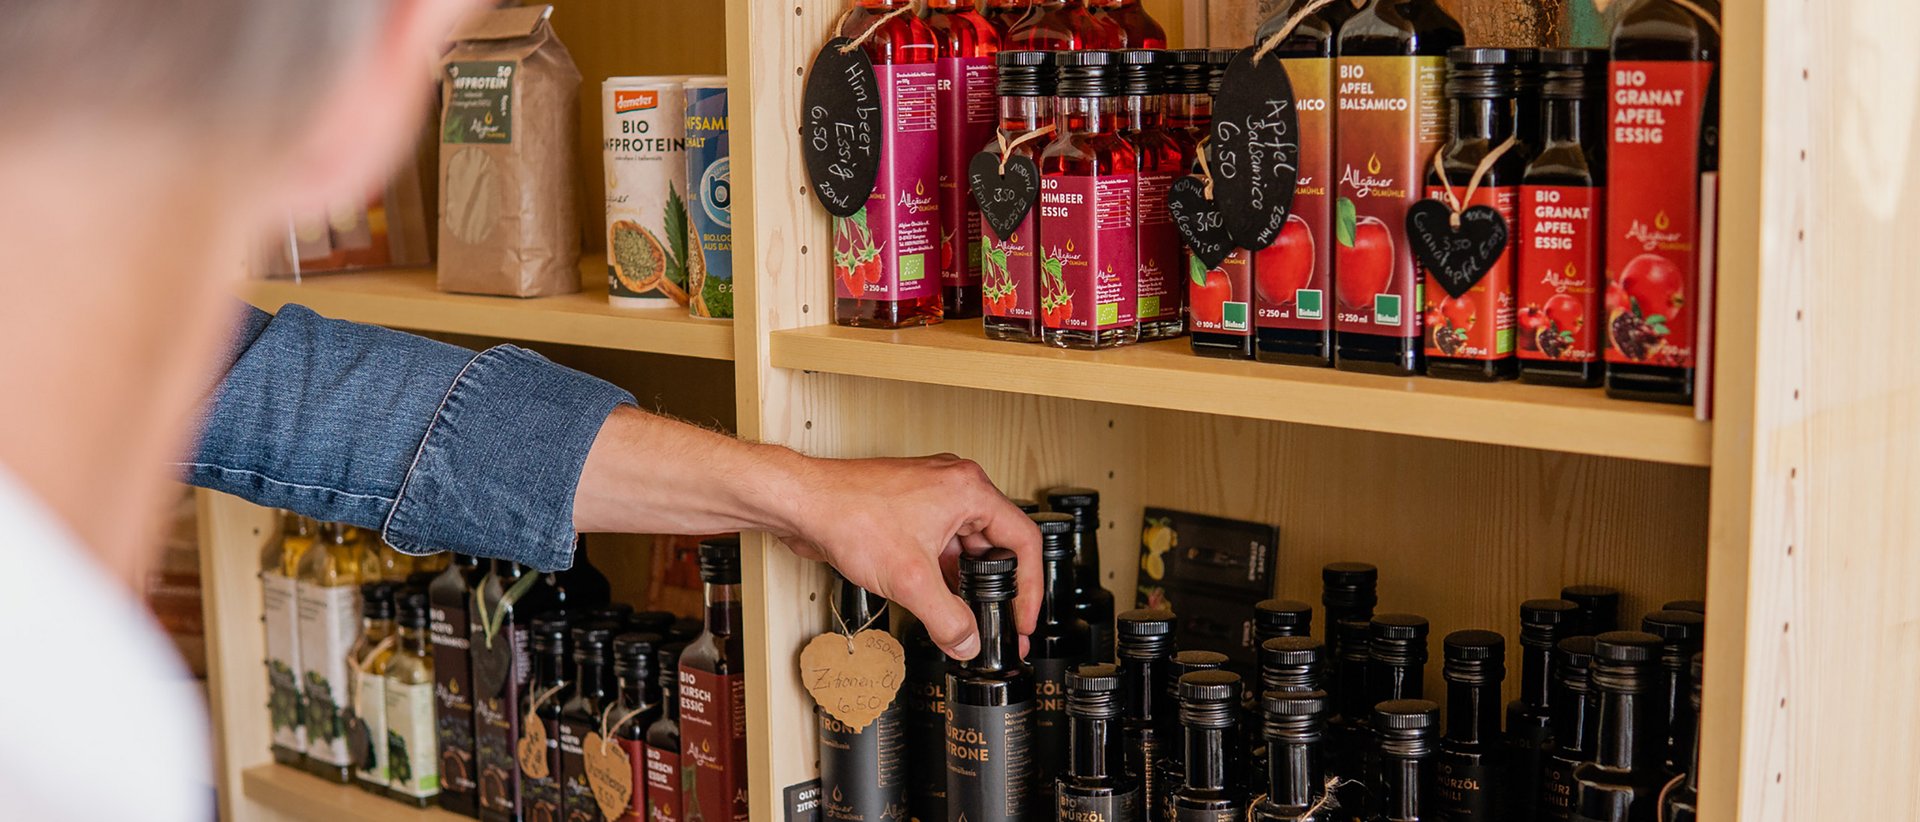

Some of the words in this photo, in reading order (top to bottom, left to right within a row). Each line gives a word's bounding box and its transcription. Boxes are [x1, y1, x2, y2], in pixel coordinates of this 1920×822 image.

[1340, 65, 1364, 79] BIO
[1615, 70, 1646, 87] BIO
[1340, 82, 1374, 95] APFEL
[617, 94, 653, 109] demeter
[1340, 98, 1408, 111] BALSAMICO
[1615, 89, 1683, 107] GRANAT
[845, 62, 878, 156] Himbeer
[1615, 108, 1665, 124] APFEL
[622, 120, 649, 133] BIO
[1264, 98, 1298, 178] Apfel
[1615, 127, 1662, 144] ESSIG
[828, 121, 857, 181] Essig
[1042, 179, 1058, 189] BIO
[1340, 163, 1393, 198] Allgäuer
[1042, 193, 1083, 205] HIMBEER
[1535, 190, 1560, 203] BIO
[1042, 206, 1069, 218] ESSIG
[1535, 206, 1590, 219] GRANAT
[1535, 221, 1575, 235] APFEL
[1535, 236, 1572, 250] ESSIG
[1266, 308, 1280, 318] 250
[1280, 309, 1289, 318] ml
[1345, 313, 1358, 323] 250
[1359, 314, 1368, 324] ml
[680, 671, 696, 685] BIO
[680, 684, 711, 703] KIRSCH
[680, 697, 705, 713] ESSIG
